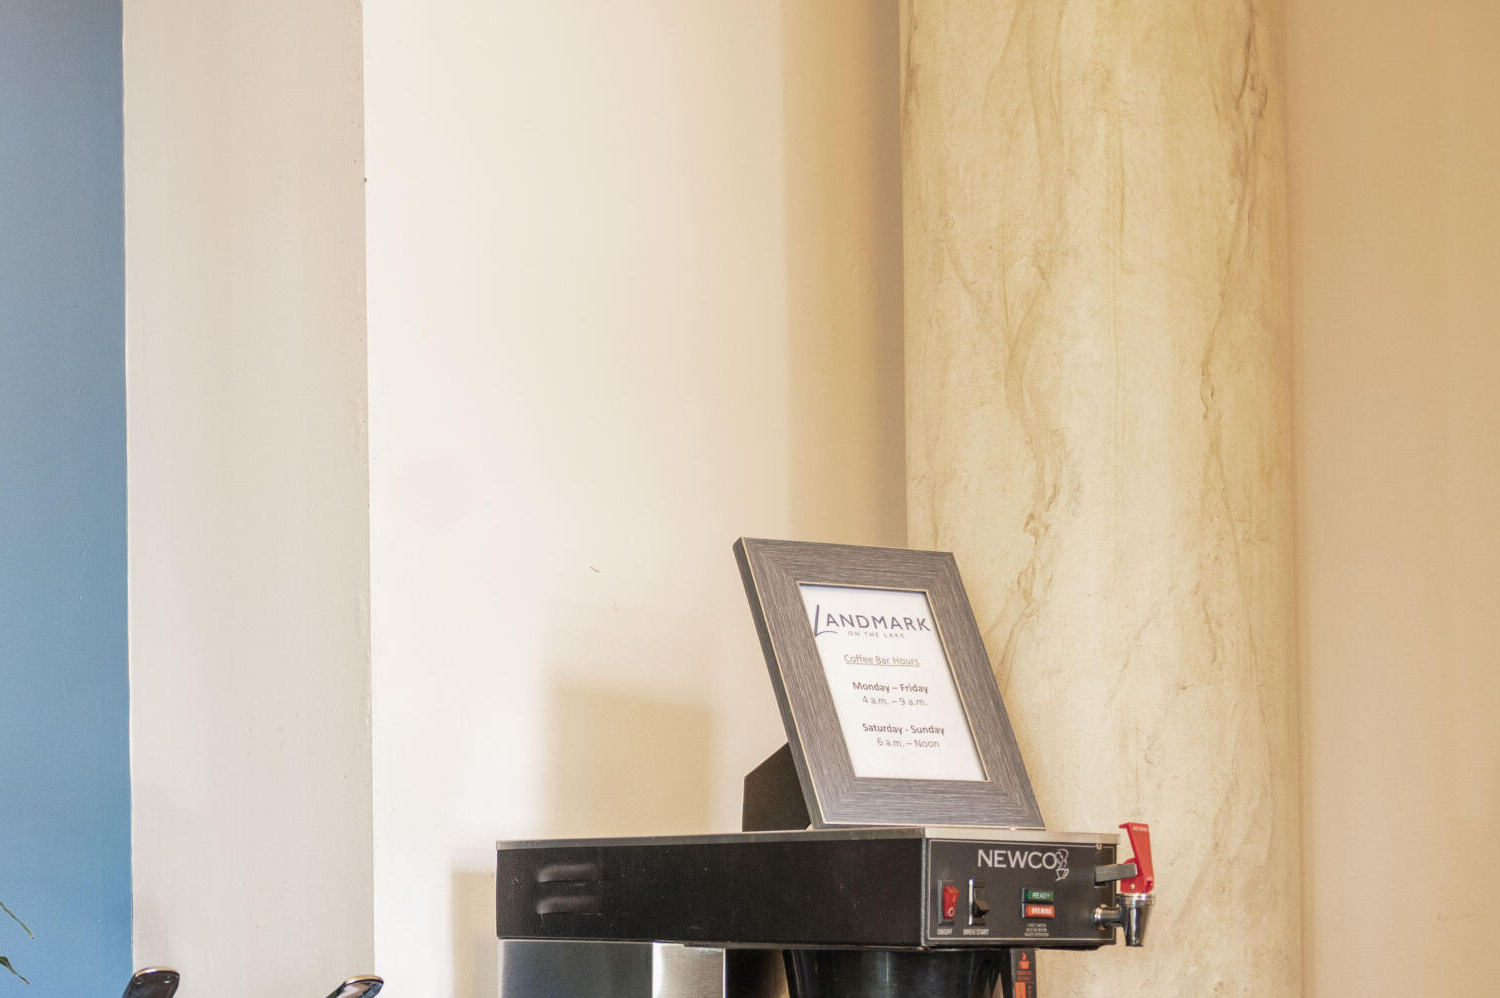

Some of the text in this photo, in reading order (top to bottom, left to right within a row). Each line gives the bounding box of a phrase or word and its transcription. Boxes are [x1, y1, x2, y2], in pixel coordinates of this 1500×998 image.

[814, 604, 931, 637] LANDMARK
[843, 654, 920, 666] Coffee Bar Hours
[852, 682, 890, 693] Monday
[899, 683, 928, 694] Friday
[862, 695, 869, 704] 4
[870, 697, 890, 705] a.m.
[898, 697, 906, 706] 9
[908, 698, 928, 706] a.m.
[862, 723, 903, 735] Saturday
[910, 725, 945, 736] Sunday
[876, 737, 884, 746] 6
[885, 739, 905, 747] a.m.
[914, 739, 940, 748] Noon
[977, 848, 1057, 870] NEWCO
[1032, 891, 1051, 900] READY
[1030, 906, 1052, 914] BREWING
